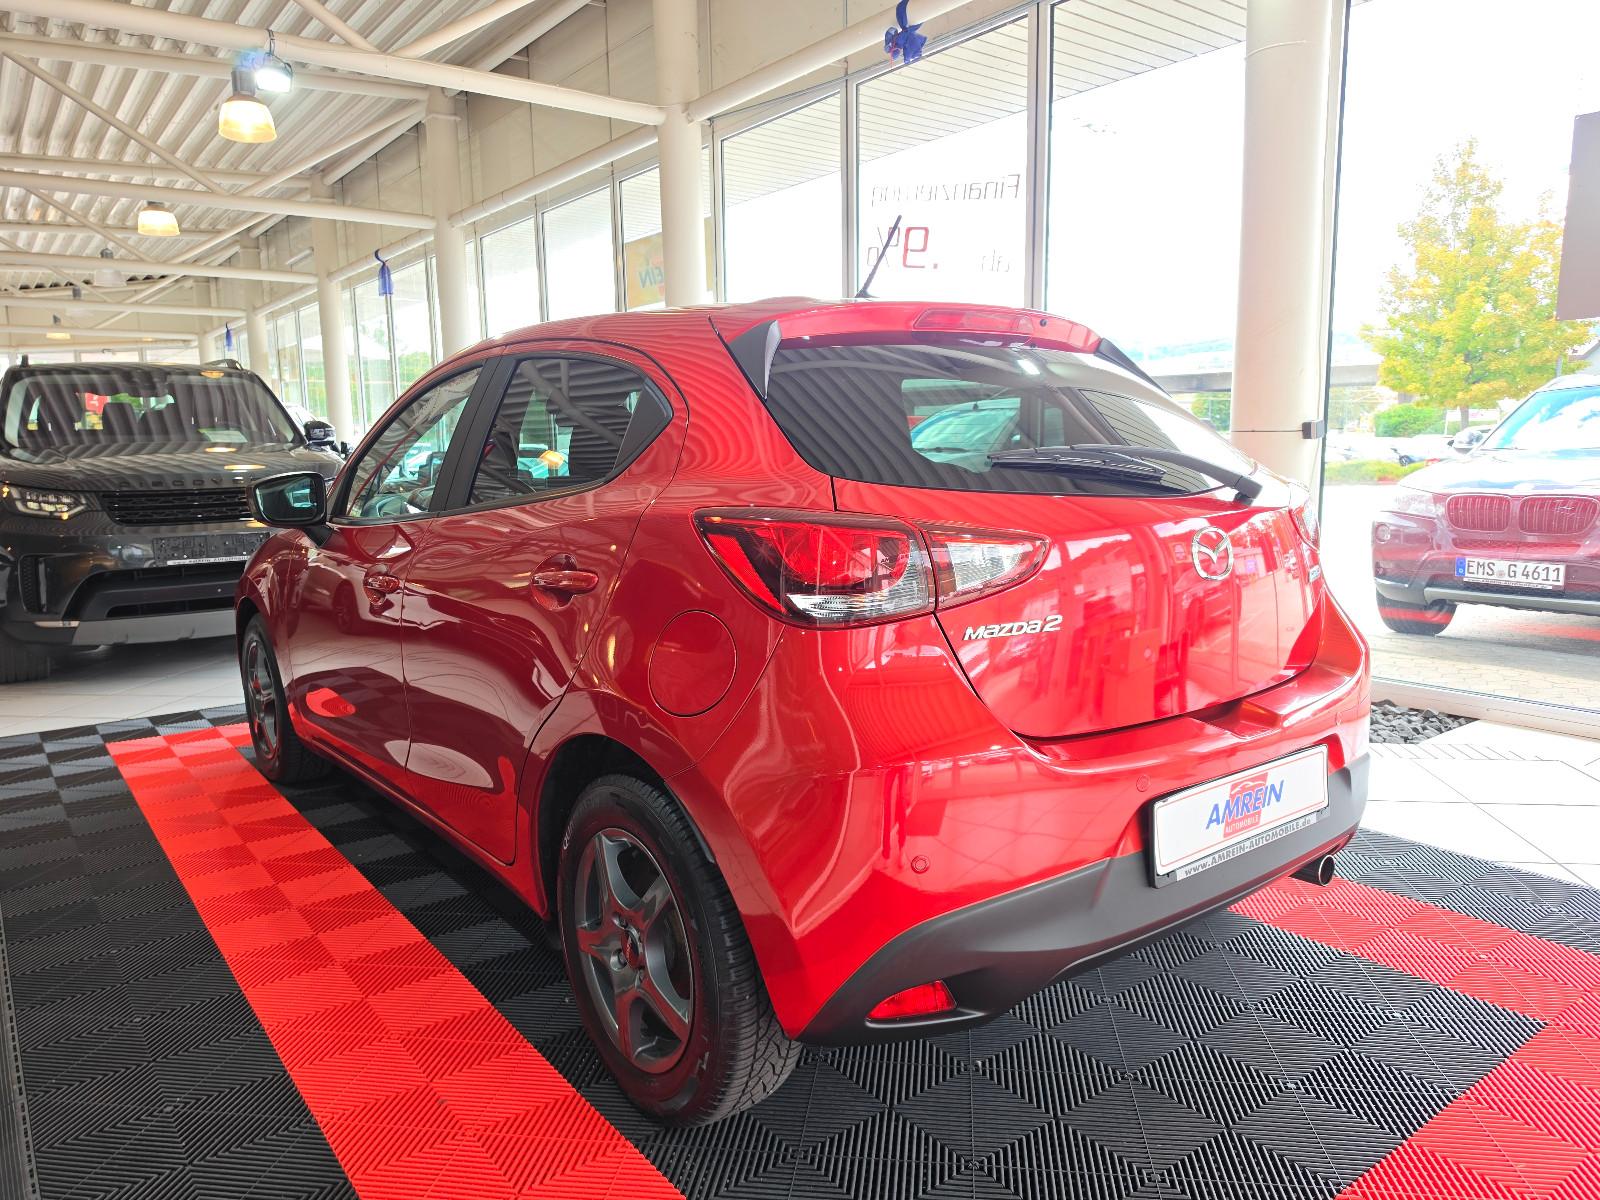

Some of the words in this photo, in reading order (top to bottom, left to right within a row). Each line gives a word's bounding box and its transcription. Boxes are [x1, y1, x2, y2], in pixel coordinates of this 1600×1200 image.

[1467, 560, 1495, 577] EMS
[1507, 563, 1517, 579] G
[1521, 564, 1561, 583] 4611
[1205, 779, 1284, 830] AMREIN
[1225, 814, 1260, 833] AUTOMOBILE
[1184, 818, 1312, 877] www.AMREIN-AUTOMOBILE.de
